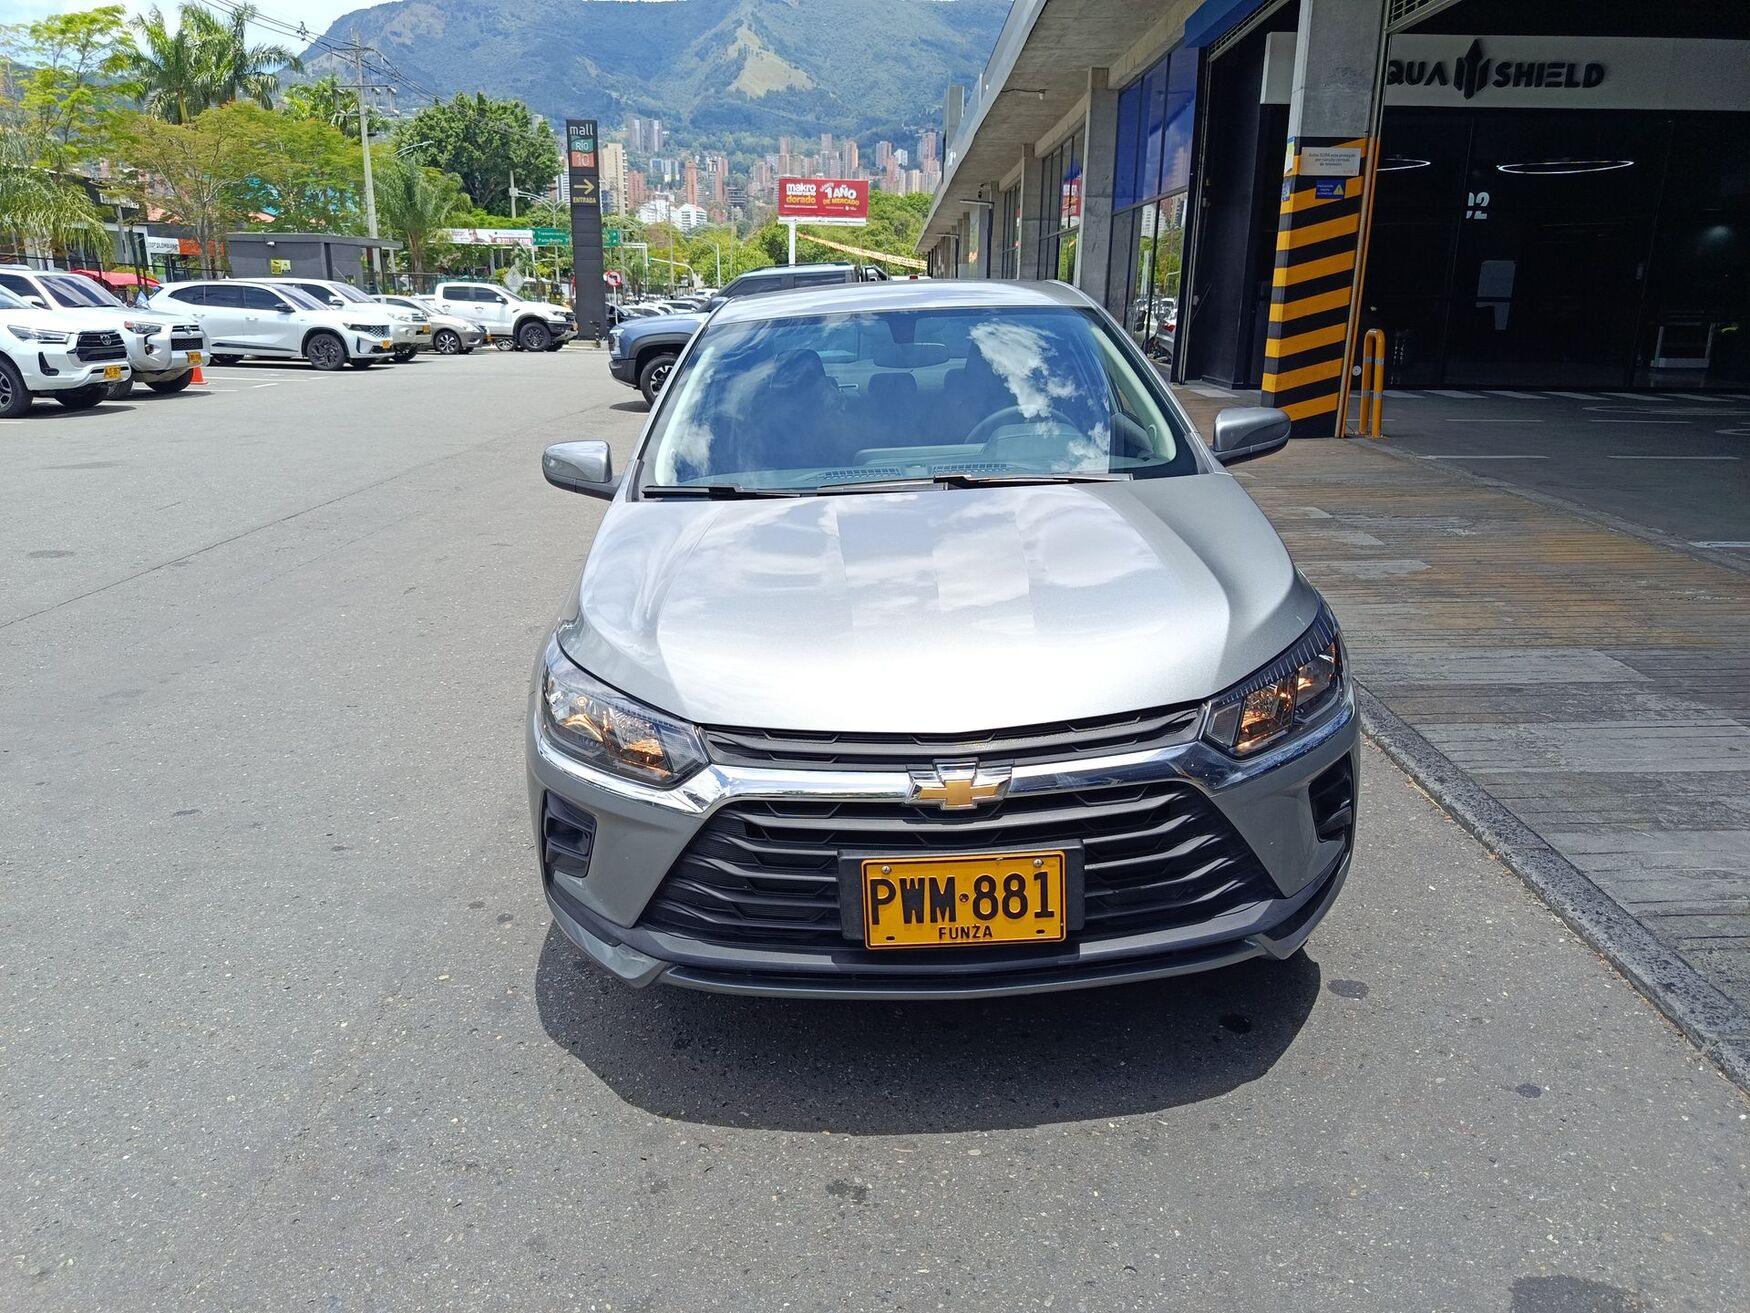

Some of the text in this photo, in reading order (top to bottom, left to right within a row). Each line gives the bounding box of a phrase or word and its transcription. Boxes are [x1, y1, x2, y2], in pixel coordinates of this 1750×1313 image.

[1387, 60, 1605, 89] QUA SHIELD
[569, 123, 594, 136] mall
[576, 153, 590, 167] 10
[786, 183, 817, 193] makro
[833, 184, 857, 200] AÑO
[572, 196, 597, 204] ENTRADA
[786, 195, 816, 204] dorado
[938, 925, 993, 940] FUNZA
